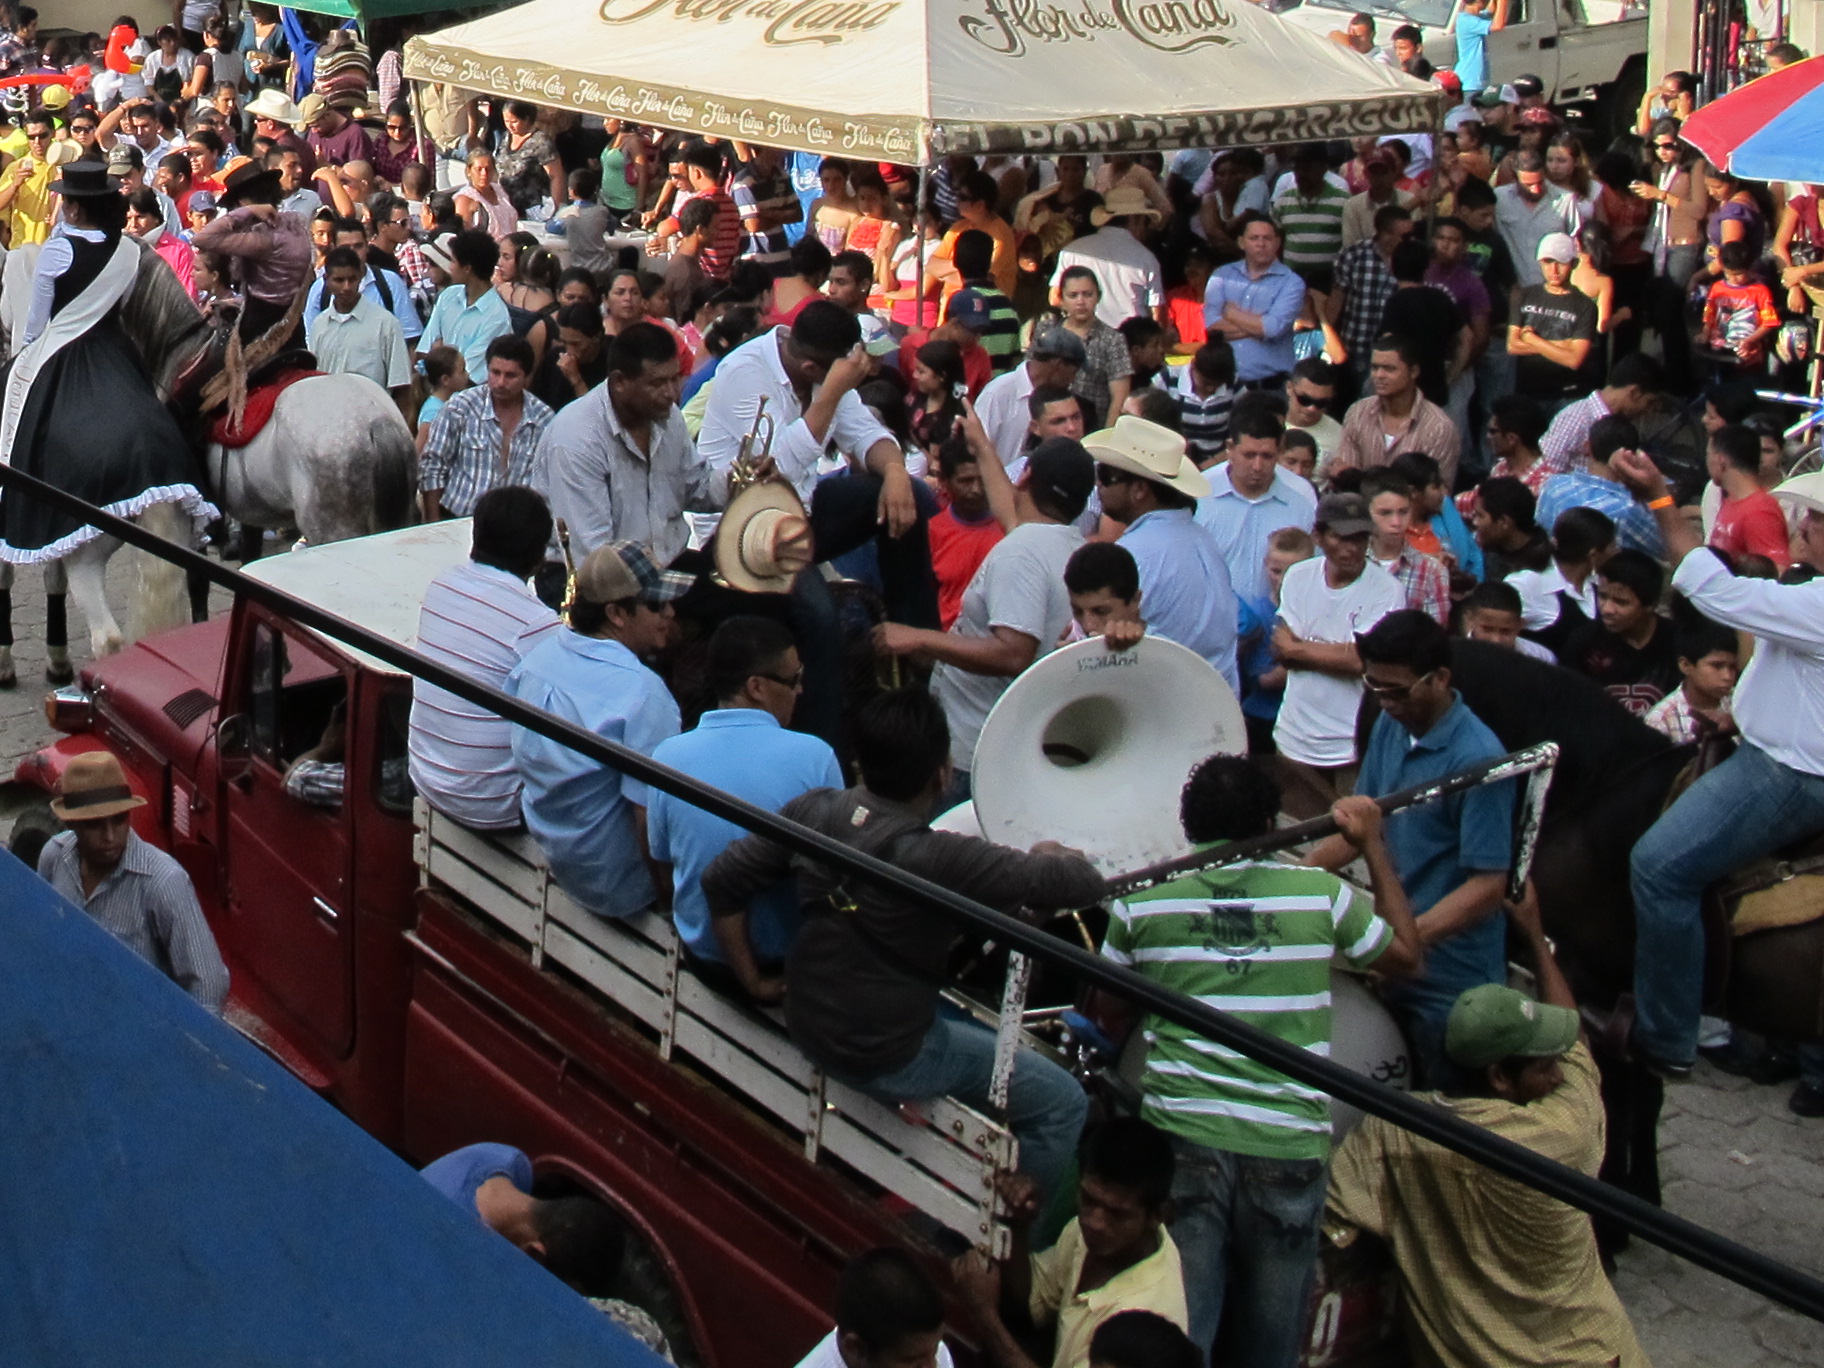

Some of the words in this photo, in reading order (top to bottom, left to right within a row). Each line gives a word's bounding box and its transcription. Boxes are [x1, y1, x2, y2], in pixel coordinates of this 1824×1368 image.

[430, 54, 455, 77] Caña
[459, 58, 485, 82] Flor
[490, 65, 512, 90] Caña
[514, 68, 537, 93] Flor
[543, 74, 567, 100] Caña
[572, 78, 599, 105] Flor
[606, 85, 632, 112] Caña
[631, 88, 661, 115] Flor
[668, 94, 694, 123] Caña
[700, 100, 731, 127] Flor
[739, 108, 765, 136] Caña
[767, 111, 799, 138] Flor
[806, 117, 833, 144] Caña
[842, 121, 875, 149] Flor
[883, 127, 913, 155] Caña
[1226, 958, 1253, 975] 67
